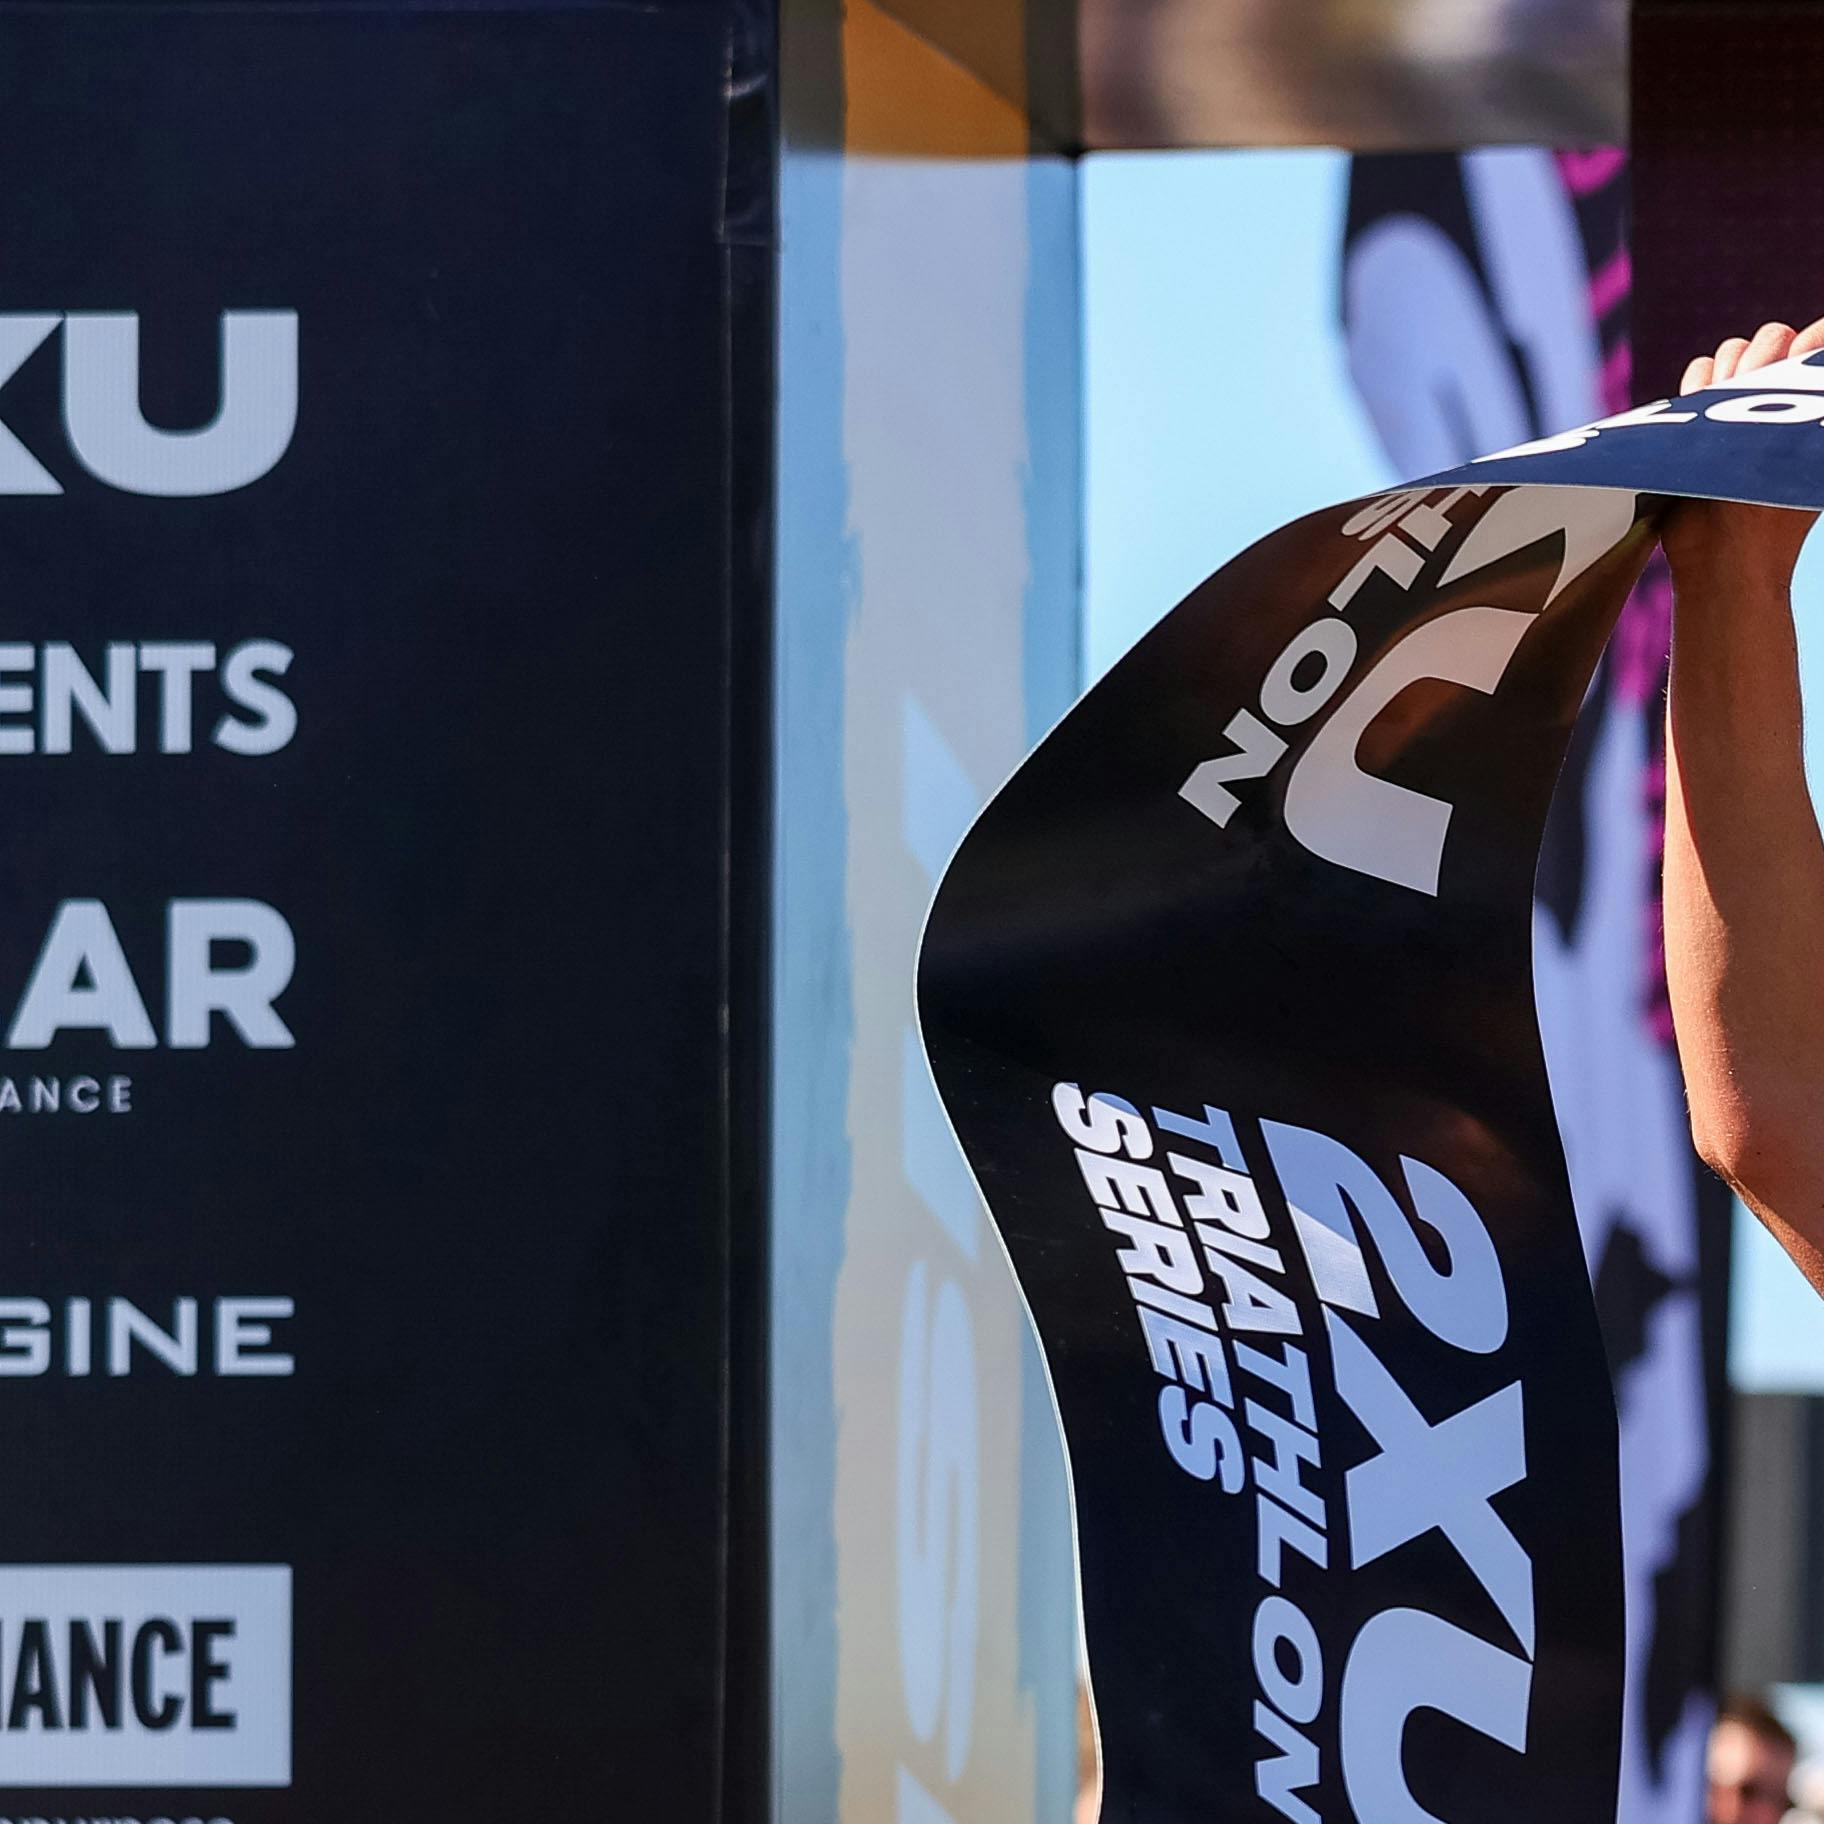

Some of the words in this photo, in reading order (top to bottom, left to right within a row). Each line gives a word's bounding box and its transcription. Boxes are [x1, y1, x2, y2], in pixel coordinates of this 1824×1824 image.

[6, 898, 297, 1049] AR
[1050, 1081, 1246, 1496] SERIES
[0, 1616, 238, 1731] ANCE
